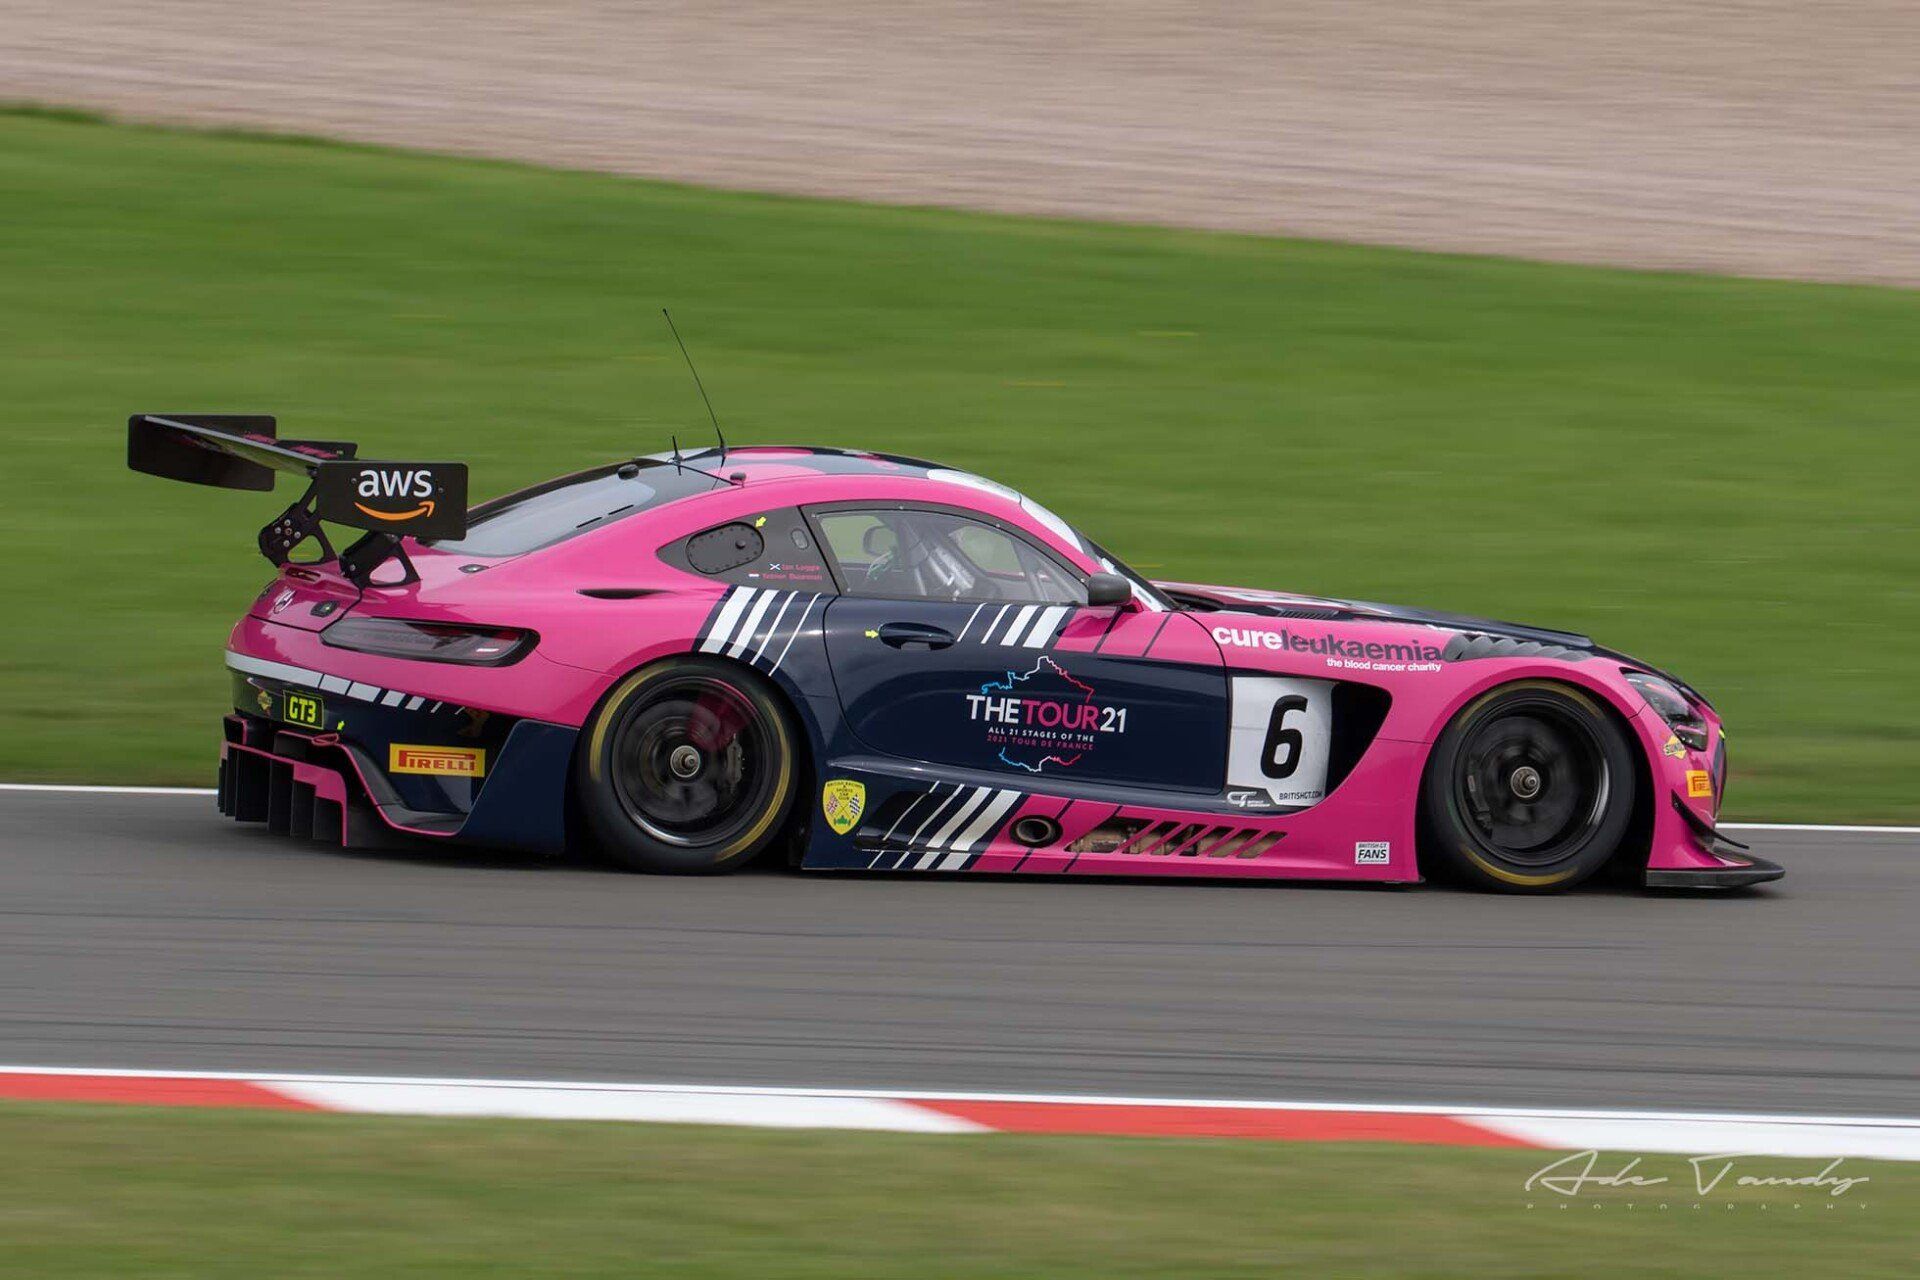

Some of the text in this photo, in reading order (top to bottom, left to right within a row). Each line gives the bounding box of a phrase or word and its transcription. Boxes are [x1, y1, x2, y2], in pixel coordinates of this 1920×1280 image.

[358, 469, 433, 498] aws
[1327, 658, 1442, 673] the blood cancer charity
[289, 696, 317, 724] GT3
[988, 726, 1095, 743] ALL 21 STAGES OF THE
[1011, 736, 1037, 747] TOUR
[1040, 739, 1053, 748] DE
[1056, 740, 1094, 751] FRANCE
[1260, 694, 1309, 780] 6
[397, 749, 477, 772] PIRELLI
[1358, 849, 1388, 859] FANS
